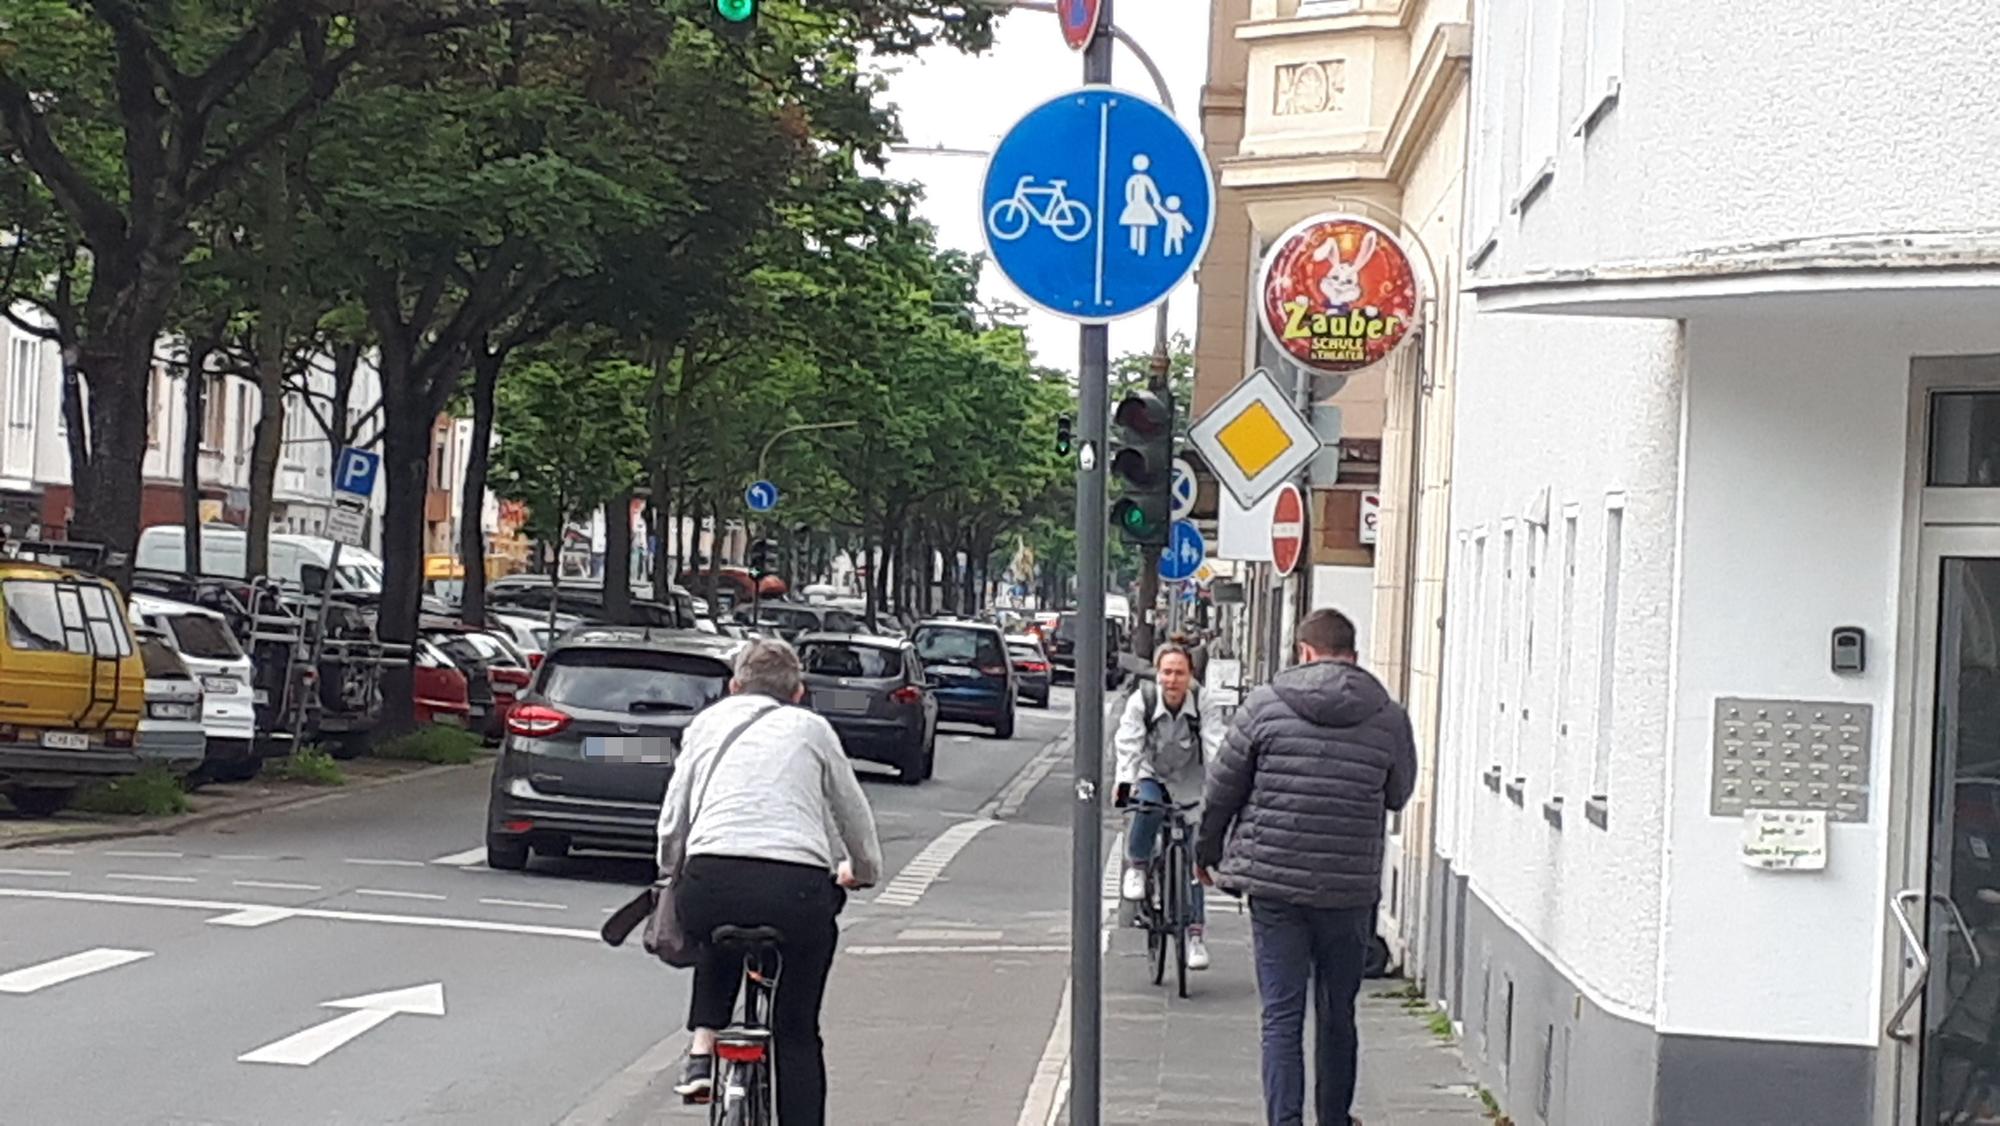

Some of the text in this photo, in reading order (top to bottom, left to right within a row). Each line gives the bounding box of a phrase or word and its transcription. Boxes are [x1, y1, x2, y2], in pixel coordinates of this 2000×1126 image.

[1284, 301, 1400, 339] Zauber
[1312, 338, 1365, 350] SCHULE
[345, 454, 370, 487] P
